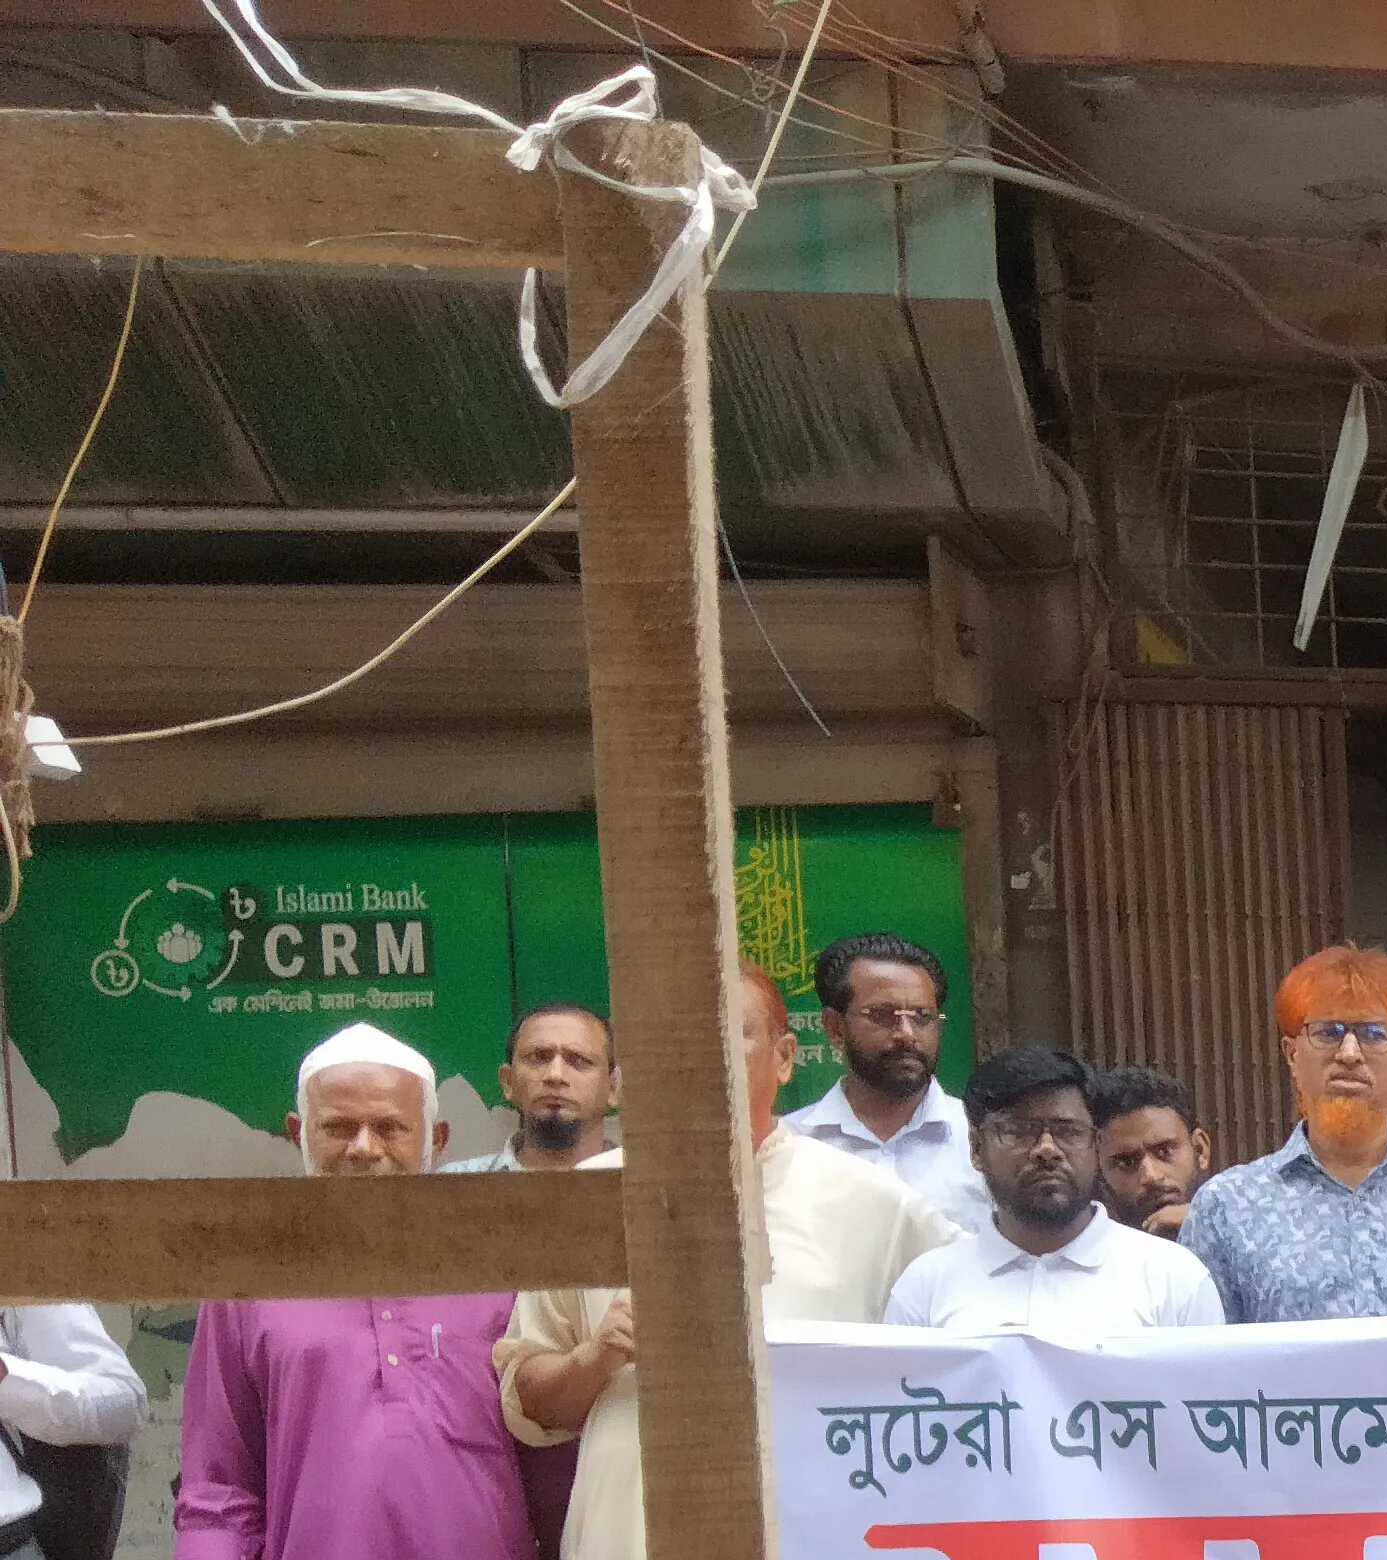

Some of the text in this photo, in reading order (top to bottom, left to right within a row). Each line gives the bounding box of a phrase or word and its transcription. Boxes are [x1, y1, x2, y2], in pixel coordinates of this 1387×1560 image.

[275, 882, 428, 913] Islami Bank
[264, 921, 426, 979] CRM
[817, 1376, 1022, 1497] লুটেরা
[1049, 1400, 1166, 1471] এস
